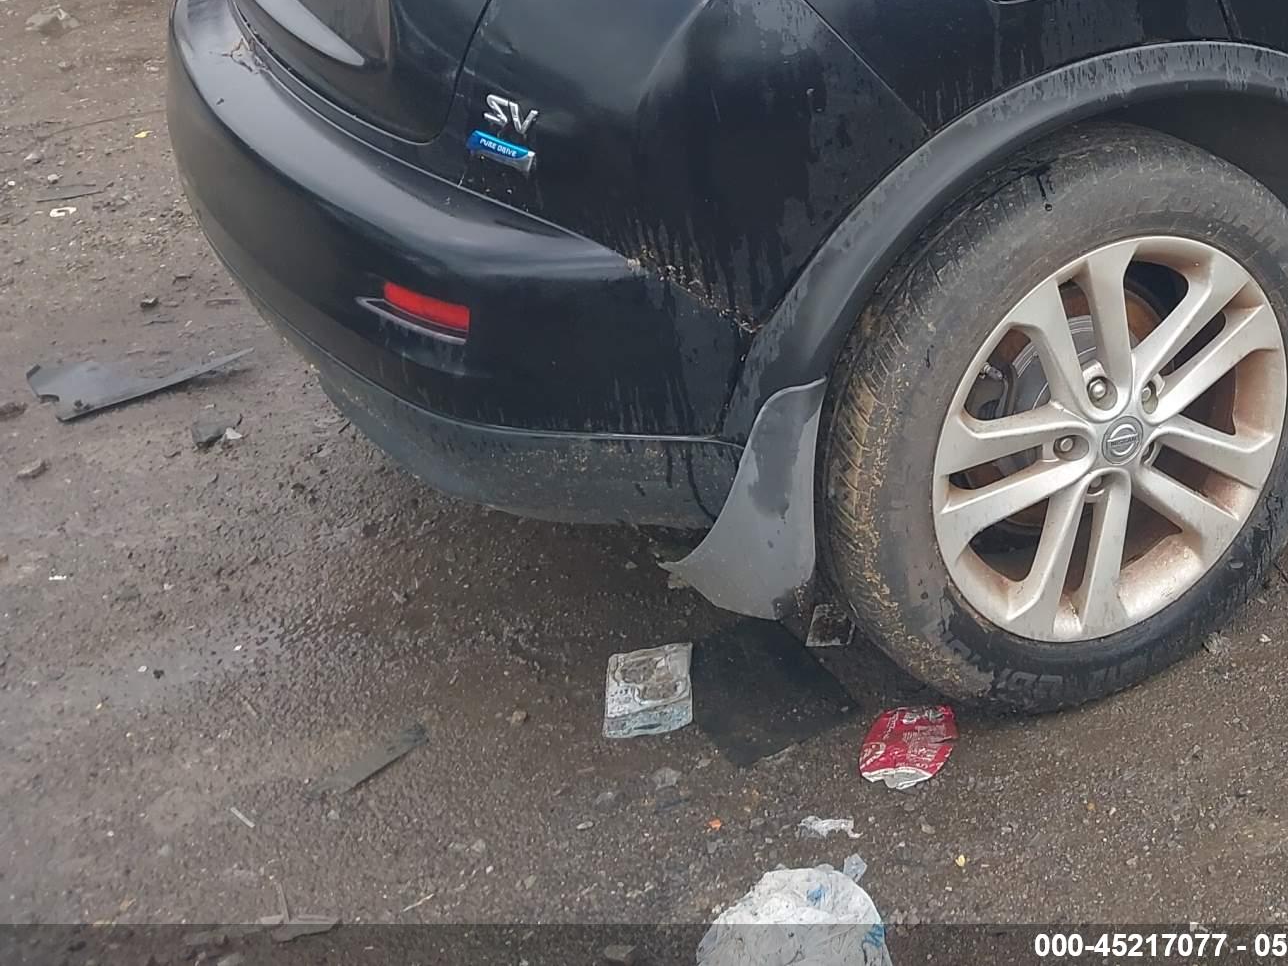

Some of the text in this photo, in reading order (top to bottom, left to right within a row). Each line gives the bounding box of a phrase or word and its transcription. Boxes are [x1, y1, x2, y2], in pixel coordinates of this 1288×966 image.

[484, 94, 538, 134] SV
[479, 138, 518, 157] PURE DRIVE
